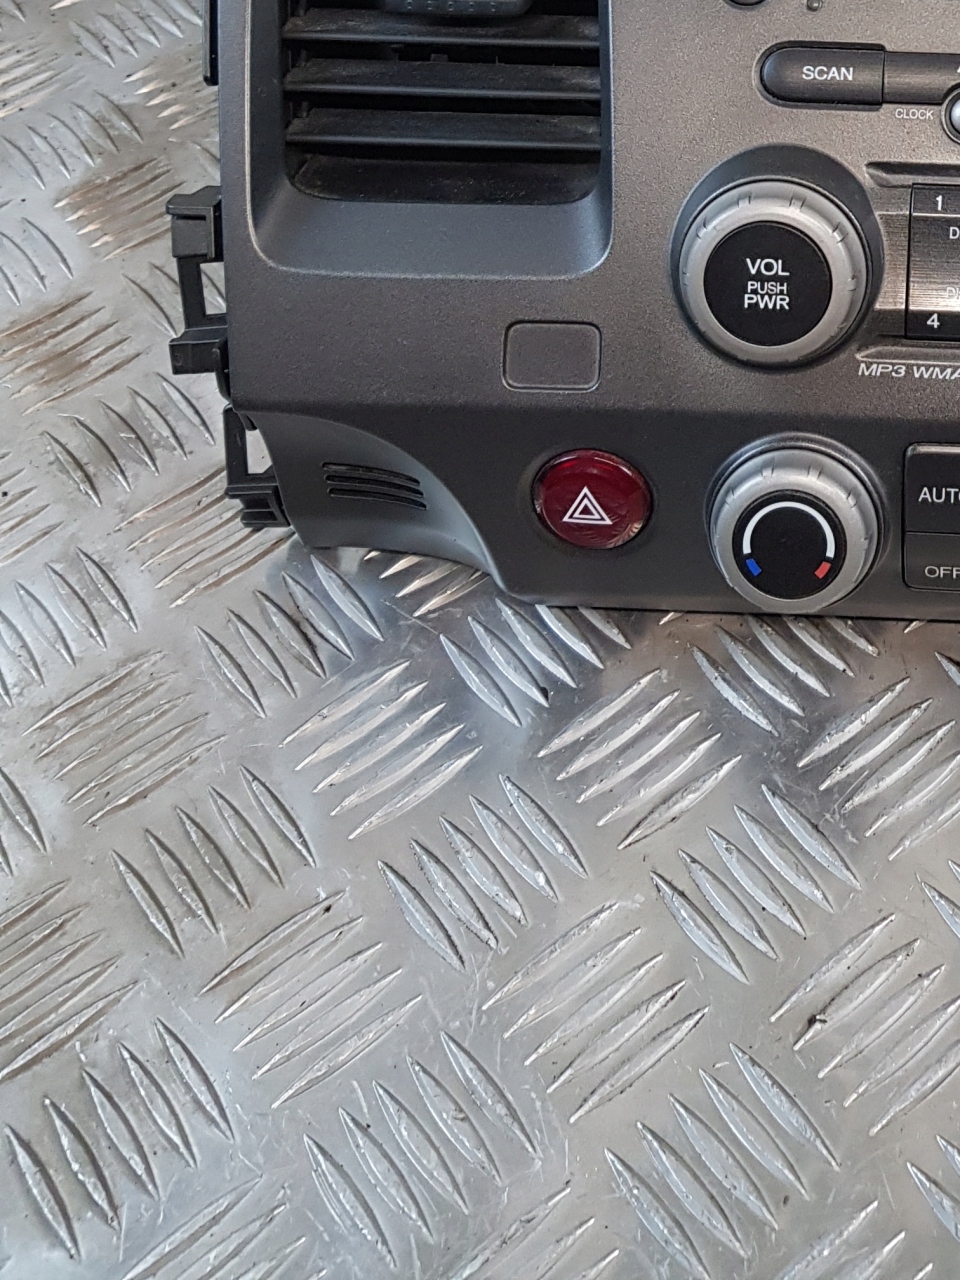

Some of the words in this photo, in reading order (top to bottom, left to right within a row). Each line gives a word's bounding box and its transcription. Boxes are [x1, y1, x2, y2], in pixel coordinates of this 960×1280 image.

[801, 65, 854, 81] SCAN
[895, 108, 934, 120] CLOCK
[936, 195, 942, 211] 1
[746, 258, 790, 276] VOL
[747, 281, 787, 295] PUSH
[744, 294, 789, 310] PWR
[926, 313, 940, 329] 4
[858, 363, 906, 378] MP3
